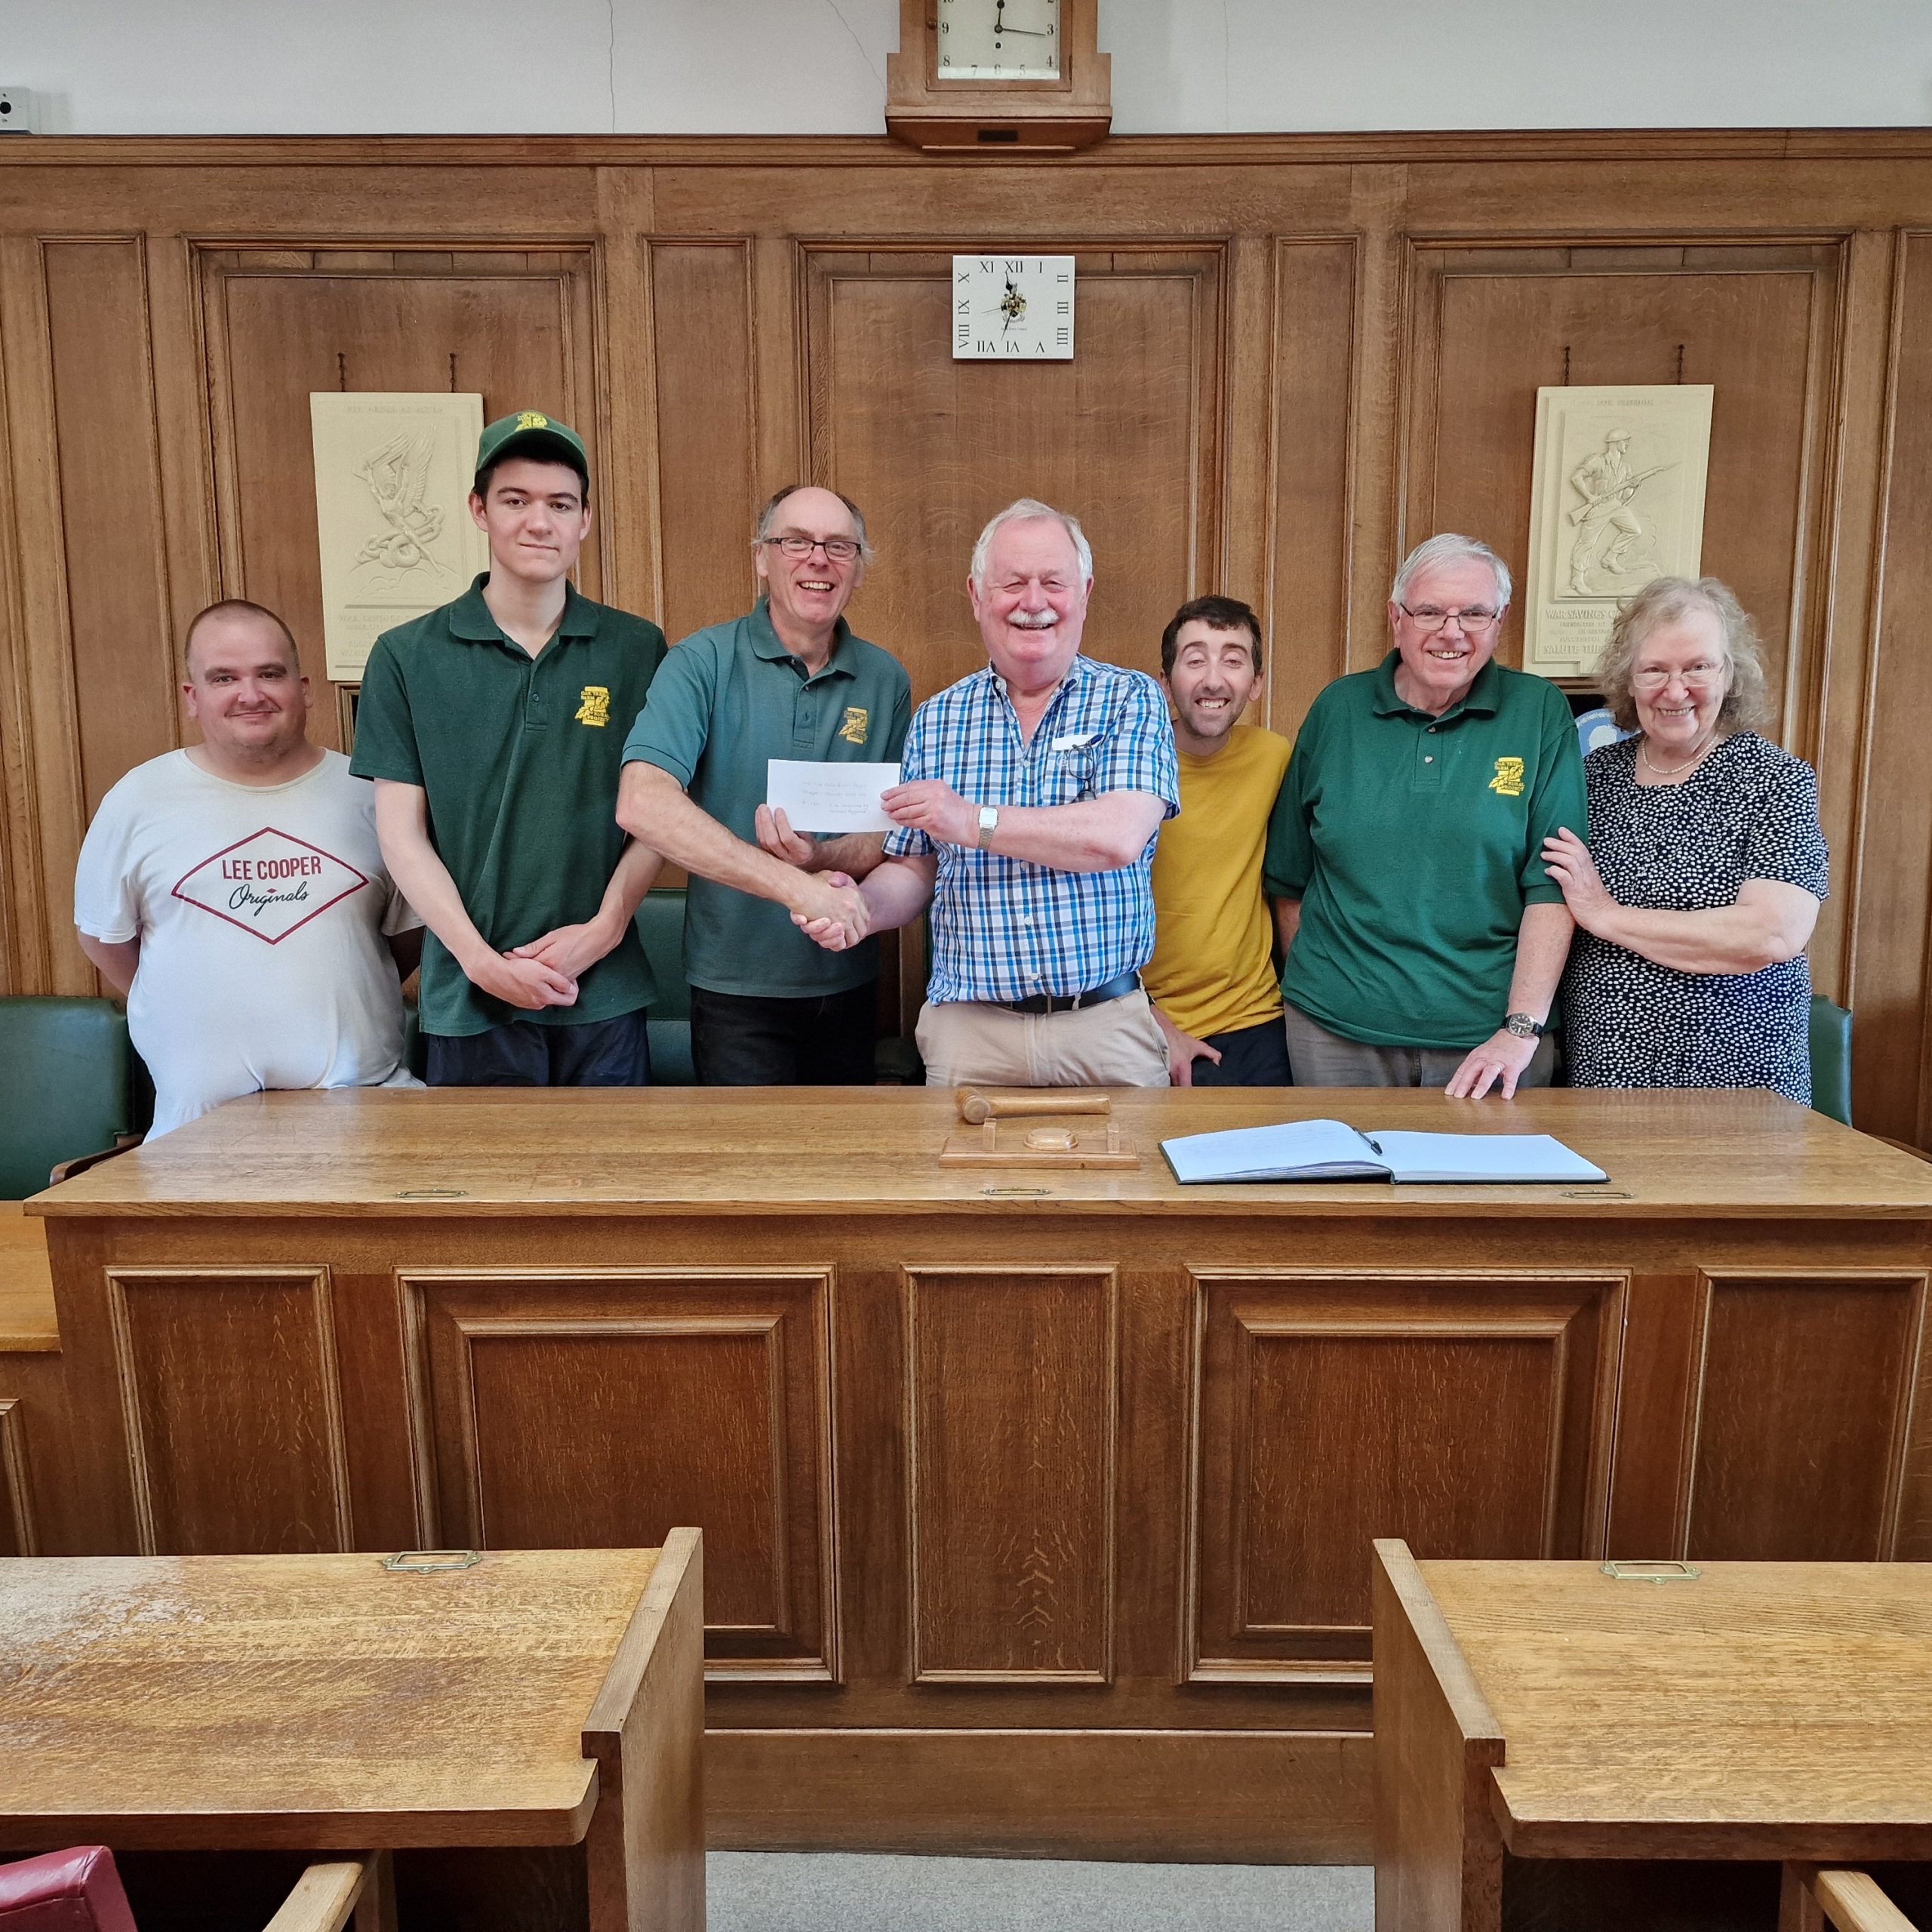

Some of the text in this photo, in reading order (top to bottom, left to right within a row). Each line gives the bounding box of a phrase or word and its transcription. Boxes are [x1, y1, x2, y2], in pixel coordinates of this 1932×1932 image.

[941, 22, 949, 35] 9
[1047, 23, 1054, 35] 3
[943, 54, 951, 66] 8
[1045, 55, 1054, 67] 4
[971, 64, 978, 76] 7
[1019, 64, 1026, 76] 5
[980, 261, 994, 273] XI
[1005, 260, 1023, 273] XII
[1038, 262, 1043, 274] I
[958, 272, 970, 283] X
[1057, 274, 1069, 283] II
[958, 299, 970, 315] IX
[1057, 301, 1069, 314] III
[958, 324, 971, 349] VIII
[1057, 327, 1069, 345] IIII
[977, 340, 995, 352] VII
[1006, 340, 1020, 352] VI
[1546, 609, 1565, 619] WAR
[1567, 609, 1606, 619] SAVINGS
[222, 856, 322, 881] LEE COOPER
[229, 881, 310, 917] Originals
